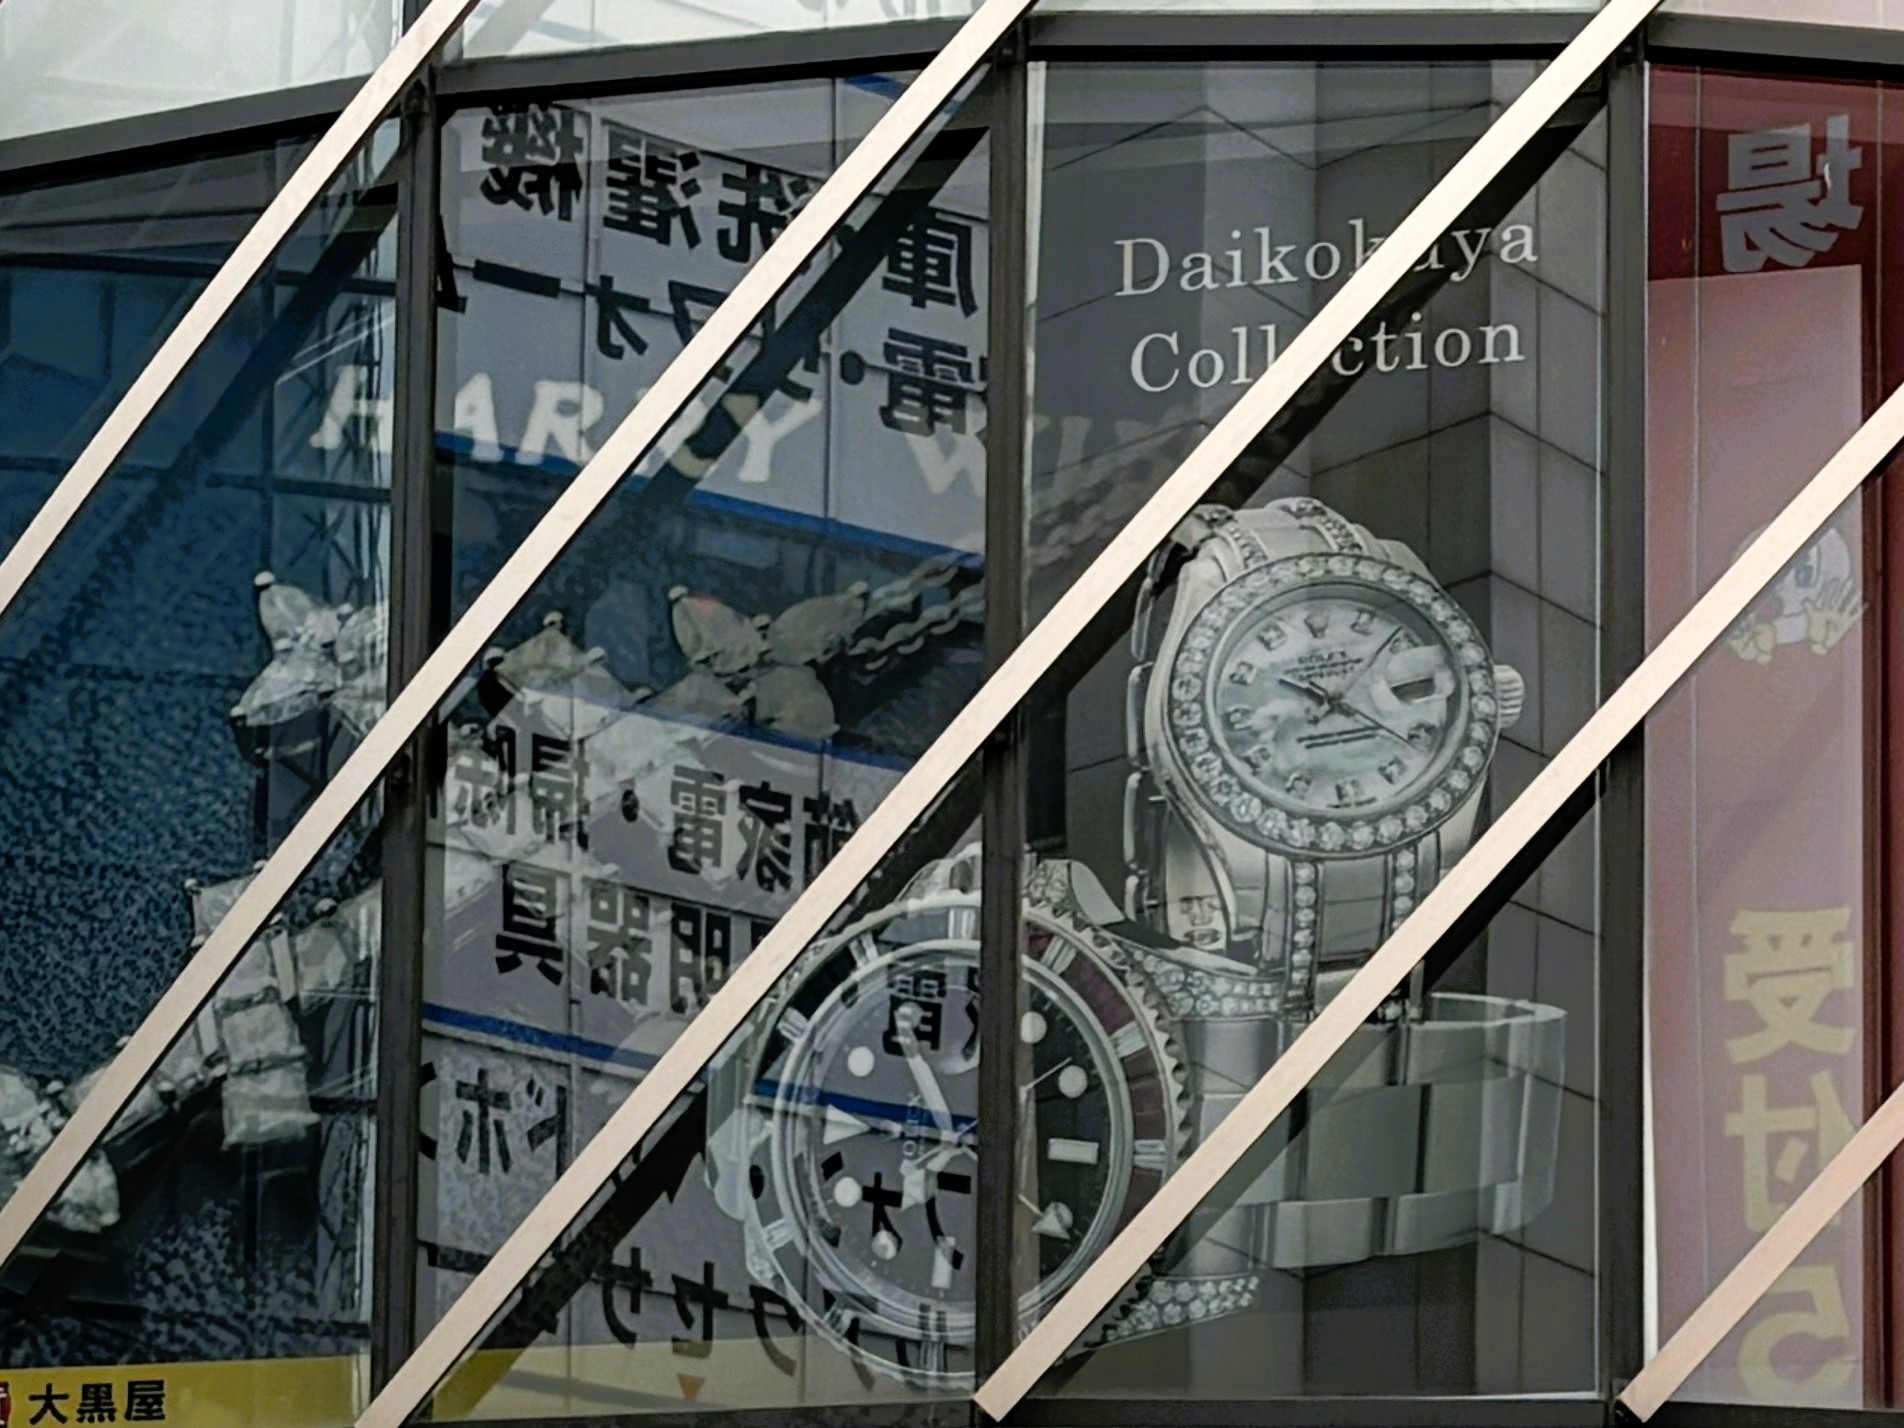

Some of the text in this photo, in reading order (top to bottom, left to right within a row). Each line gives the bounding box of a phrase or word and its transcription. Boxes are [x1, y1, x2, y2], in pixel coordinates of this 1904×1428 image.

[1130, 312, 1526, 393] Collction
[27, 1378, 168, 1427] 大黒屋
